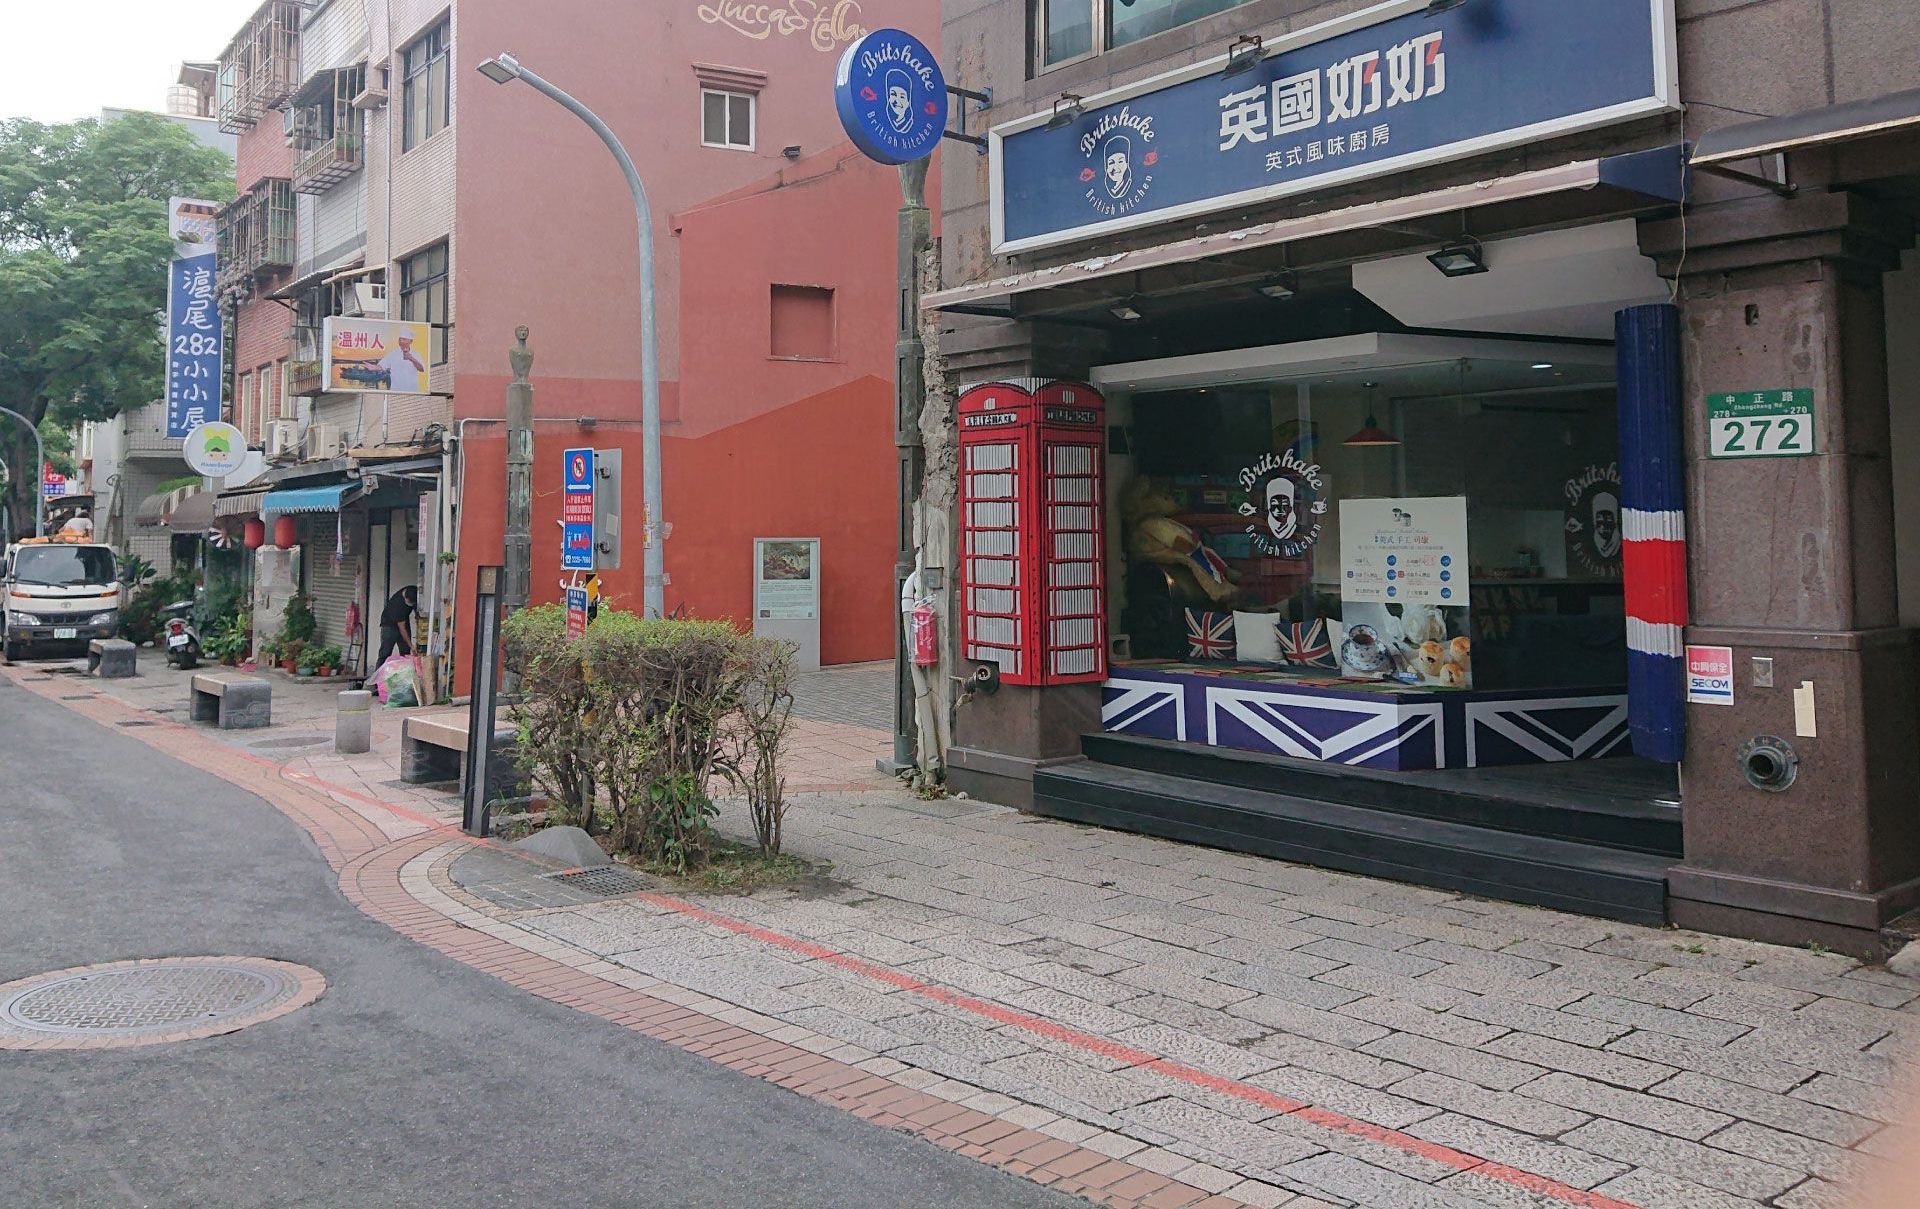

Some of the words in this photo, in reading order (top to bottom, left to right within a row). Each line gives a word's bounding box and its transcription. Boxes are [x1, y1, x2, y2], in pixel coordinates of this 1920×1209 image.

[860, 42, 935, 92] Britshake
[1219, 30, 1447, 152] 英國奶奶
[866, 110, 899, 149] British
[902, 122, 934, 150] kitchen
[1079, 105, 1159, 159] Britshake
[1265, 123, 1390, 172] 英式風味廚房
[1085, 189, 1116, 216] British
[1119, 174, 1154, 216] kitchen
[1713, 410, 1731, 418] 278
[1725, 391, 1794, 405] 中正路
[1790, 406, 1808, 415] 270
[1723, 418, 1801, 452] 272
[1239, 448, 1323, 493] Britshake
[1284, 523, 1322, 557] kitchen
[1691, 678, 1729, 689] SECOM
